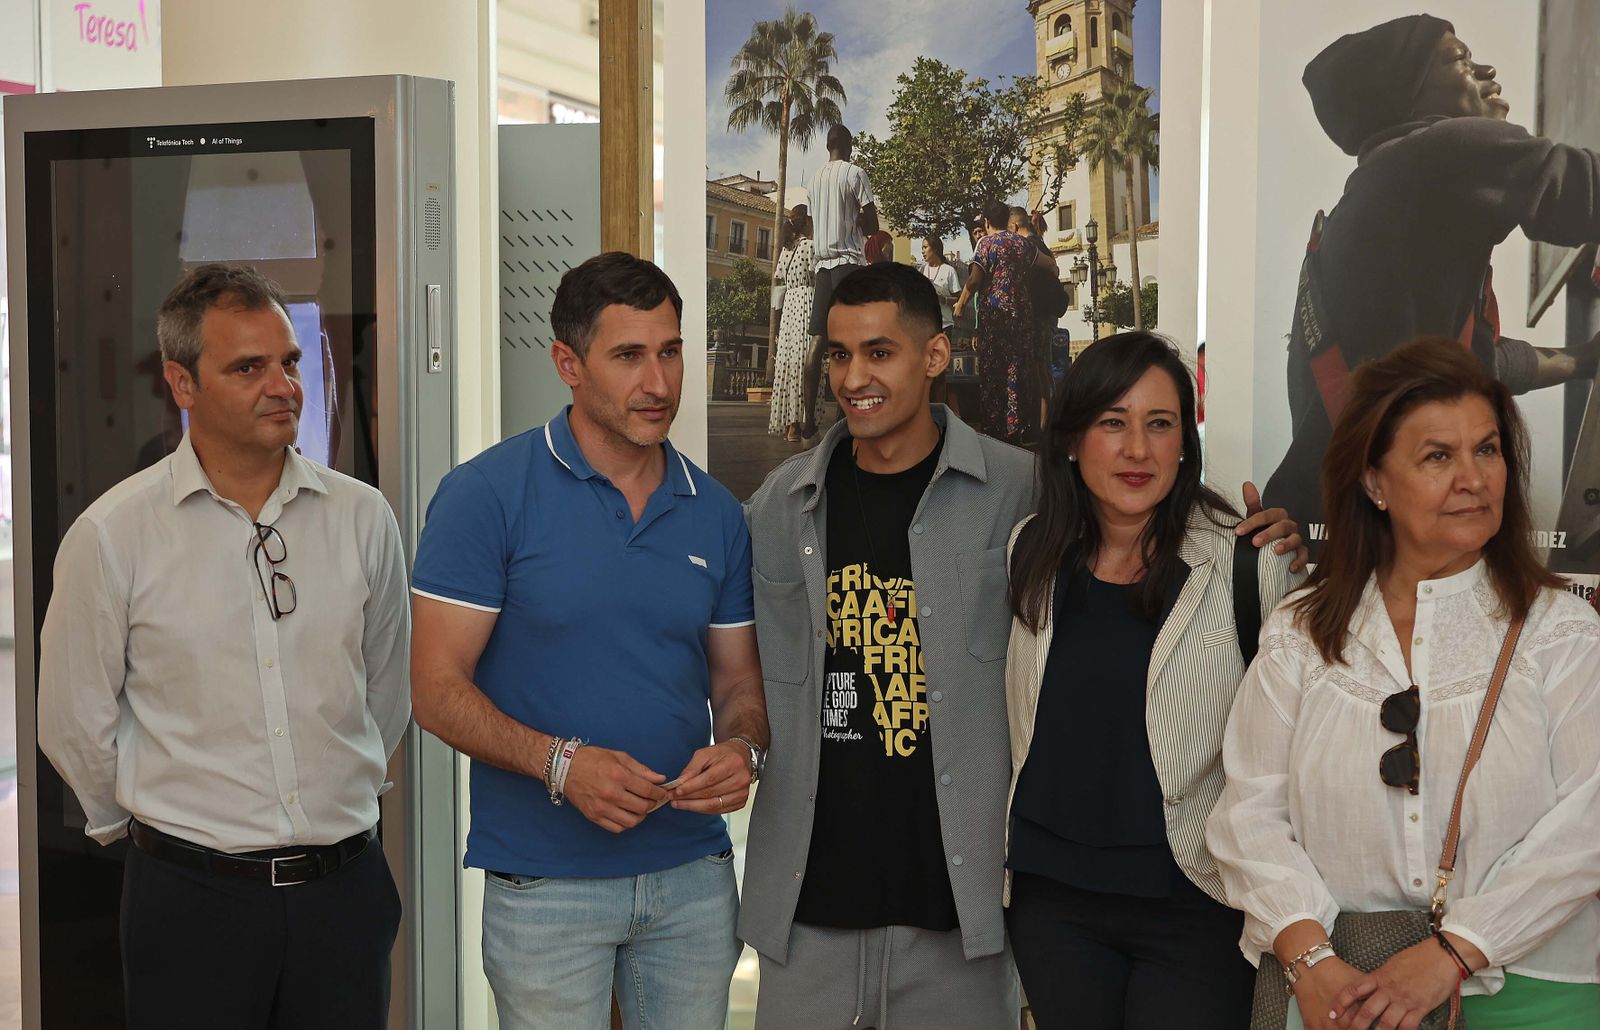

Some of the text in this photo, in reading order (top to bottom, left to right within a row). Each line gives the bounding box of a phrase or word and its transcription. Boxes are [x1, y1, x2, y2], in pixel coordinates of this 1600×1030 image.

[74, 3, 137, 52] Teresa
[224, 137, 243, 146] Things
[1527, 530, 1567, 549] NDEZ
[863, 645, 925, 674] FRI
[826, 671, 857, 691] PTURE
[832, 690, 858, 709] GOOD
[822, 708, 849, 728] TIMES
